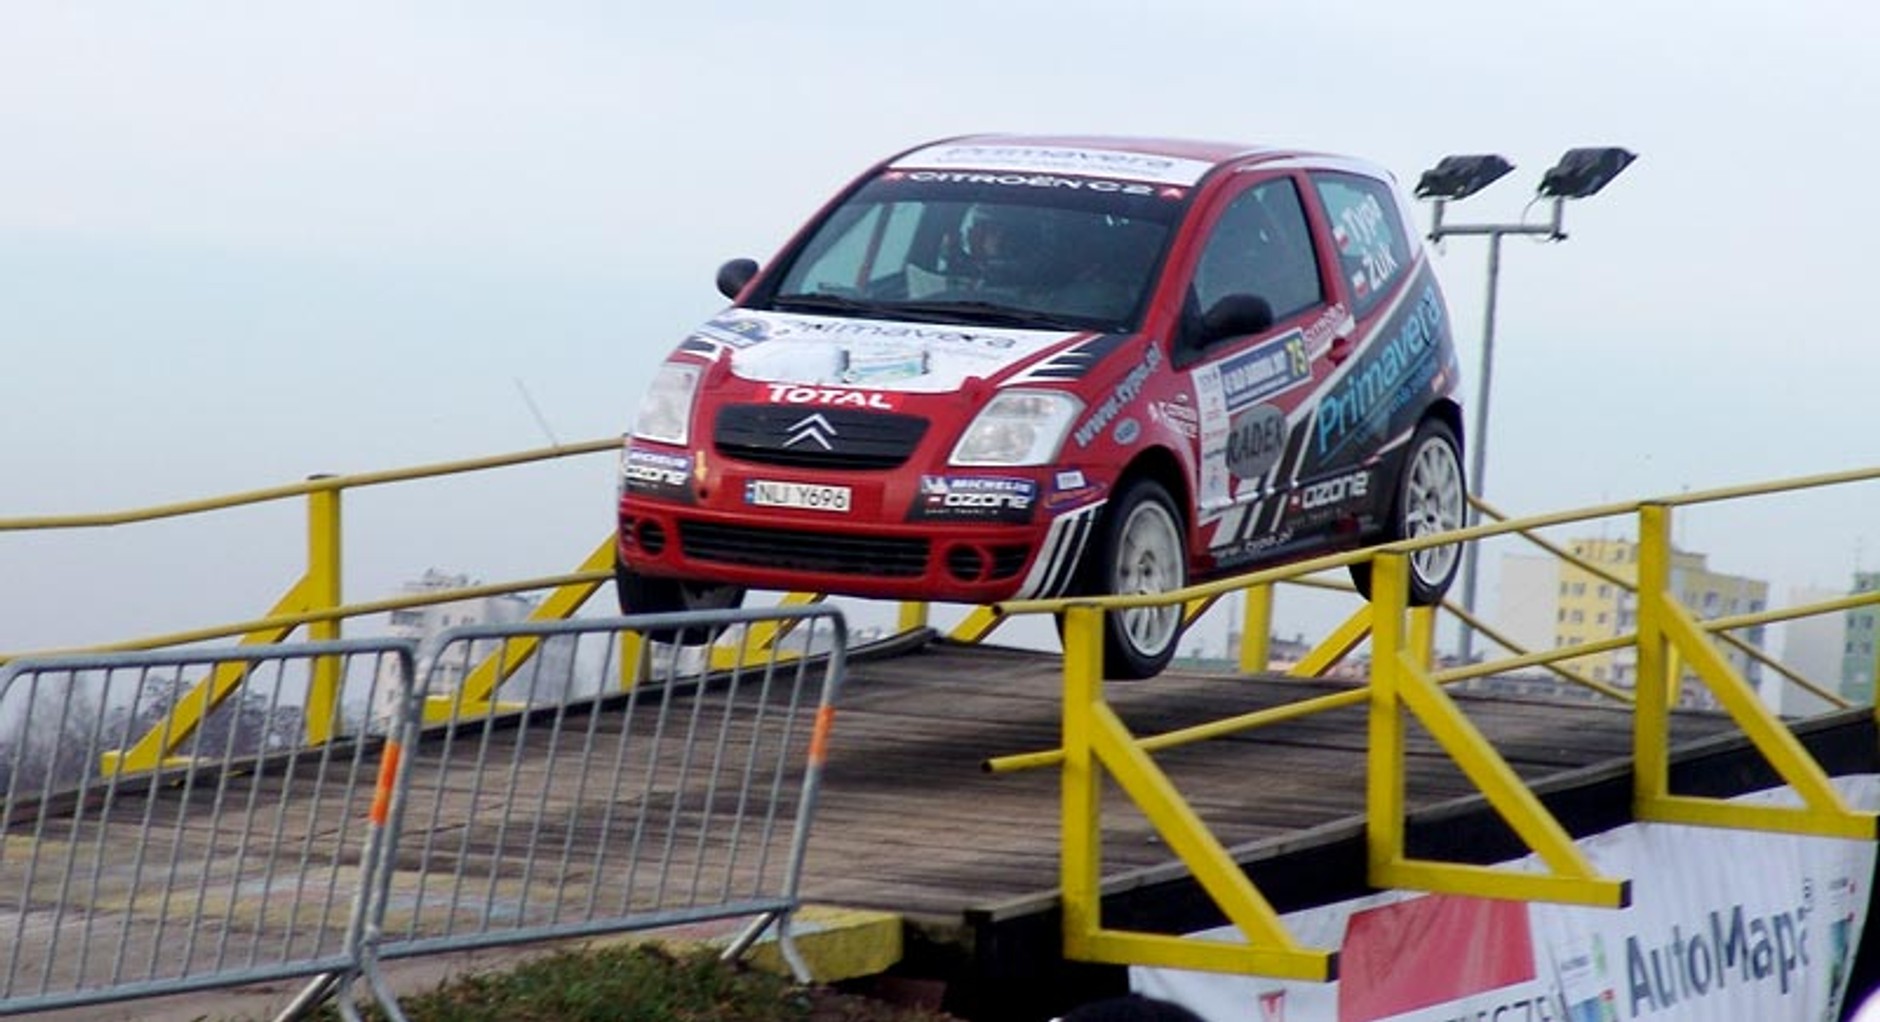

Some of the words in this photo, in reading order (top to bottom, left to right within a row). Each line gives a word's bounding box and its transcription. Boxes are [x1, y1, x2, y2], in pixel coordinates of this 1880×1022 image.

[1318, 286, 1442, 453] Primavera
[767, 383, 893, 409] TOTAL
[795, 485, 848, 509] Y696
[951, 478, 1031, 493] MICHELIN
